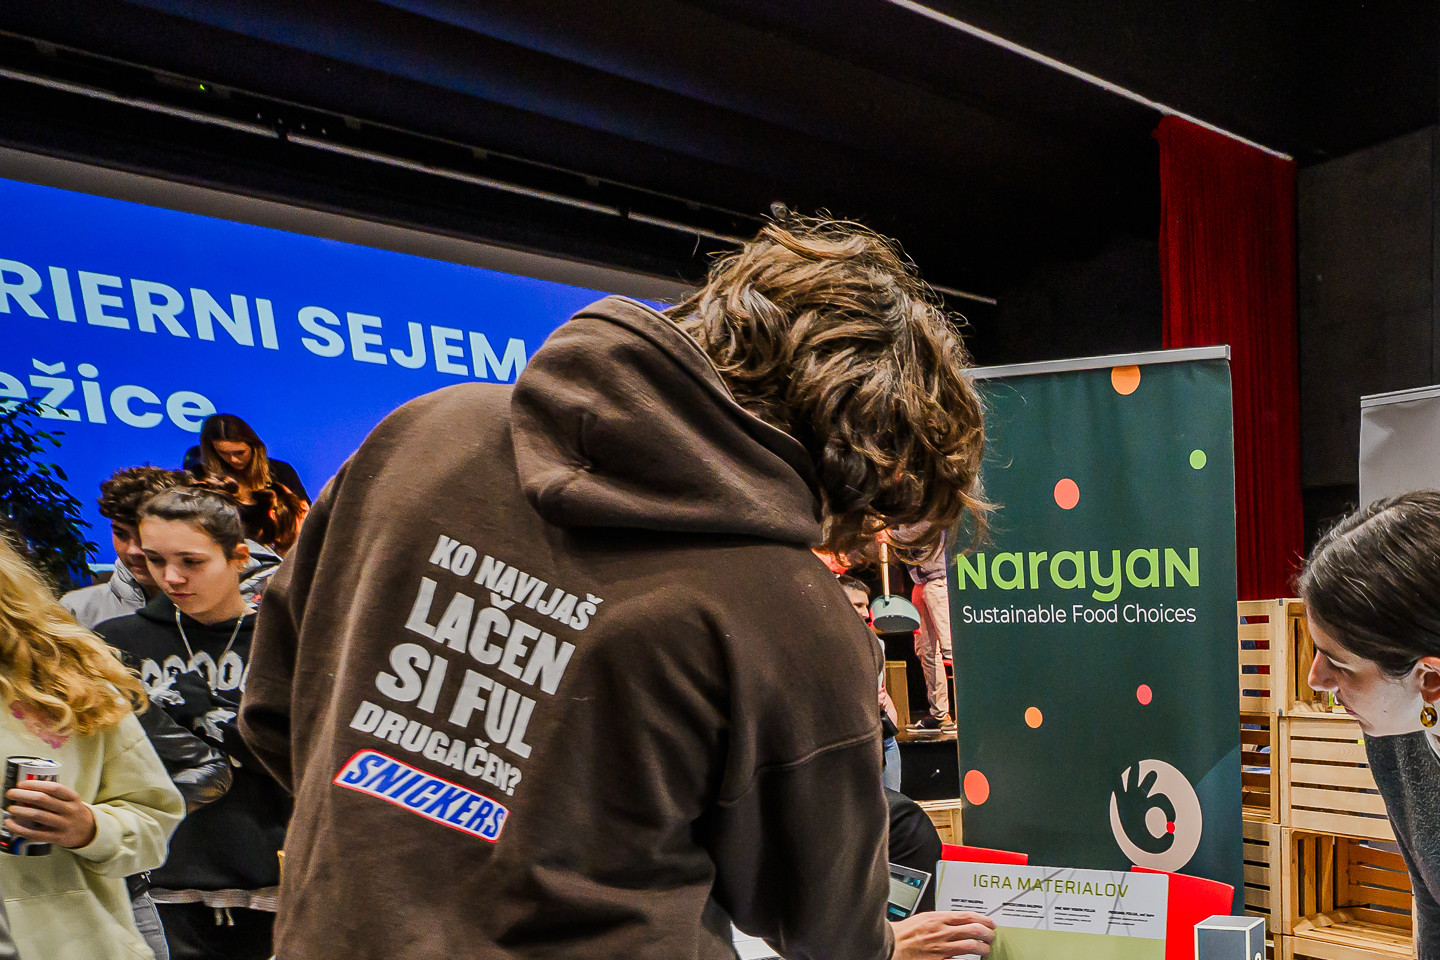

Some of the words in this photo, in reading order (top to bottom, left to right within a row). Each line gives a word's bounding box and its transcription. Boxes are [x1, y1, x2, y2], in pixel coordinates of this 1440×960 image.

[297, 306, 528, 382] SEJEM
[429, 534, 478, 577] KO
[474, 555, 604, 631] NAVIJAŠ
[962, 604, 1067, 624] Sustainable
[1072, 604, 1119, 624] Food
[1122, 603, 1197, 624] Choices
[405, 576, 577, 696] LAČEN
[375, 643, 449, 714] SI
[448, 669, 537, 758] FUL
[349, 700, 522, 796] DRUGAČEN?
[342, 753, 506, 838] SNICKERS
[973, 873, 1012, 890] IGRA
[1017, 876, 1129, 898] MATERIALOV
